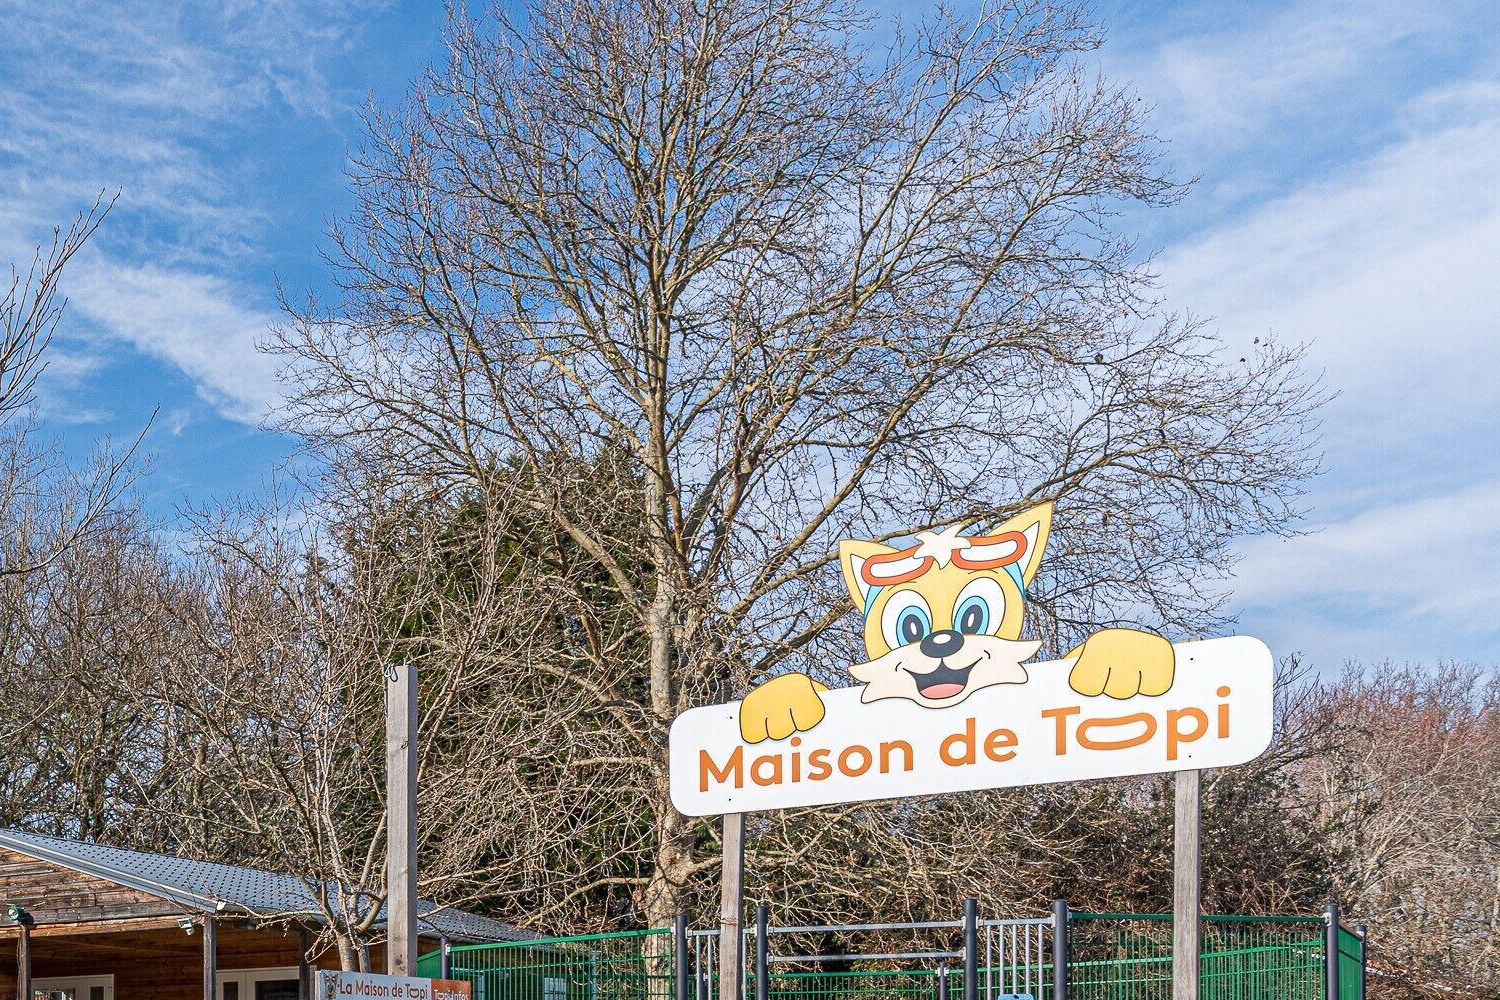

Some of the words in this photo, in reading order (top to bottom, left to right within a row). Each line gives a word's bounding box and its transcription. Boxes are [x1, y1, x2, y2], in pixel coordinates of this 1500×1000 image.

[698, 737, 914, 793] Maison
[938, 717, 1019, 767] de
[1041, 685, 1231, 762] Topi
[340, 979, 353, 995] La
[355, 980, 389, 997] Maison
[391, 982, 403, 998] de
